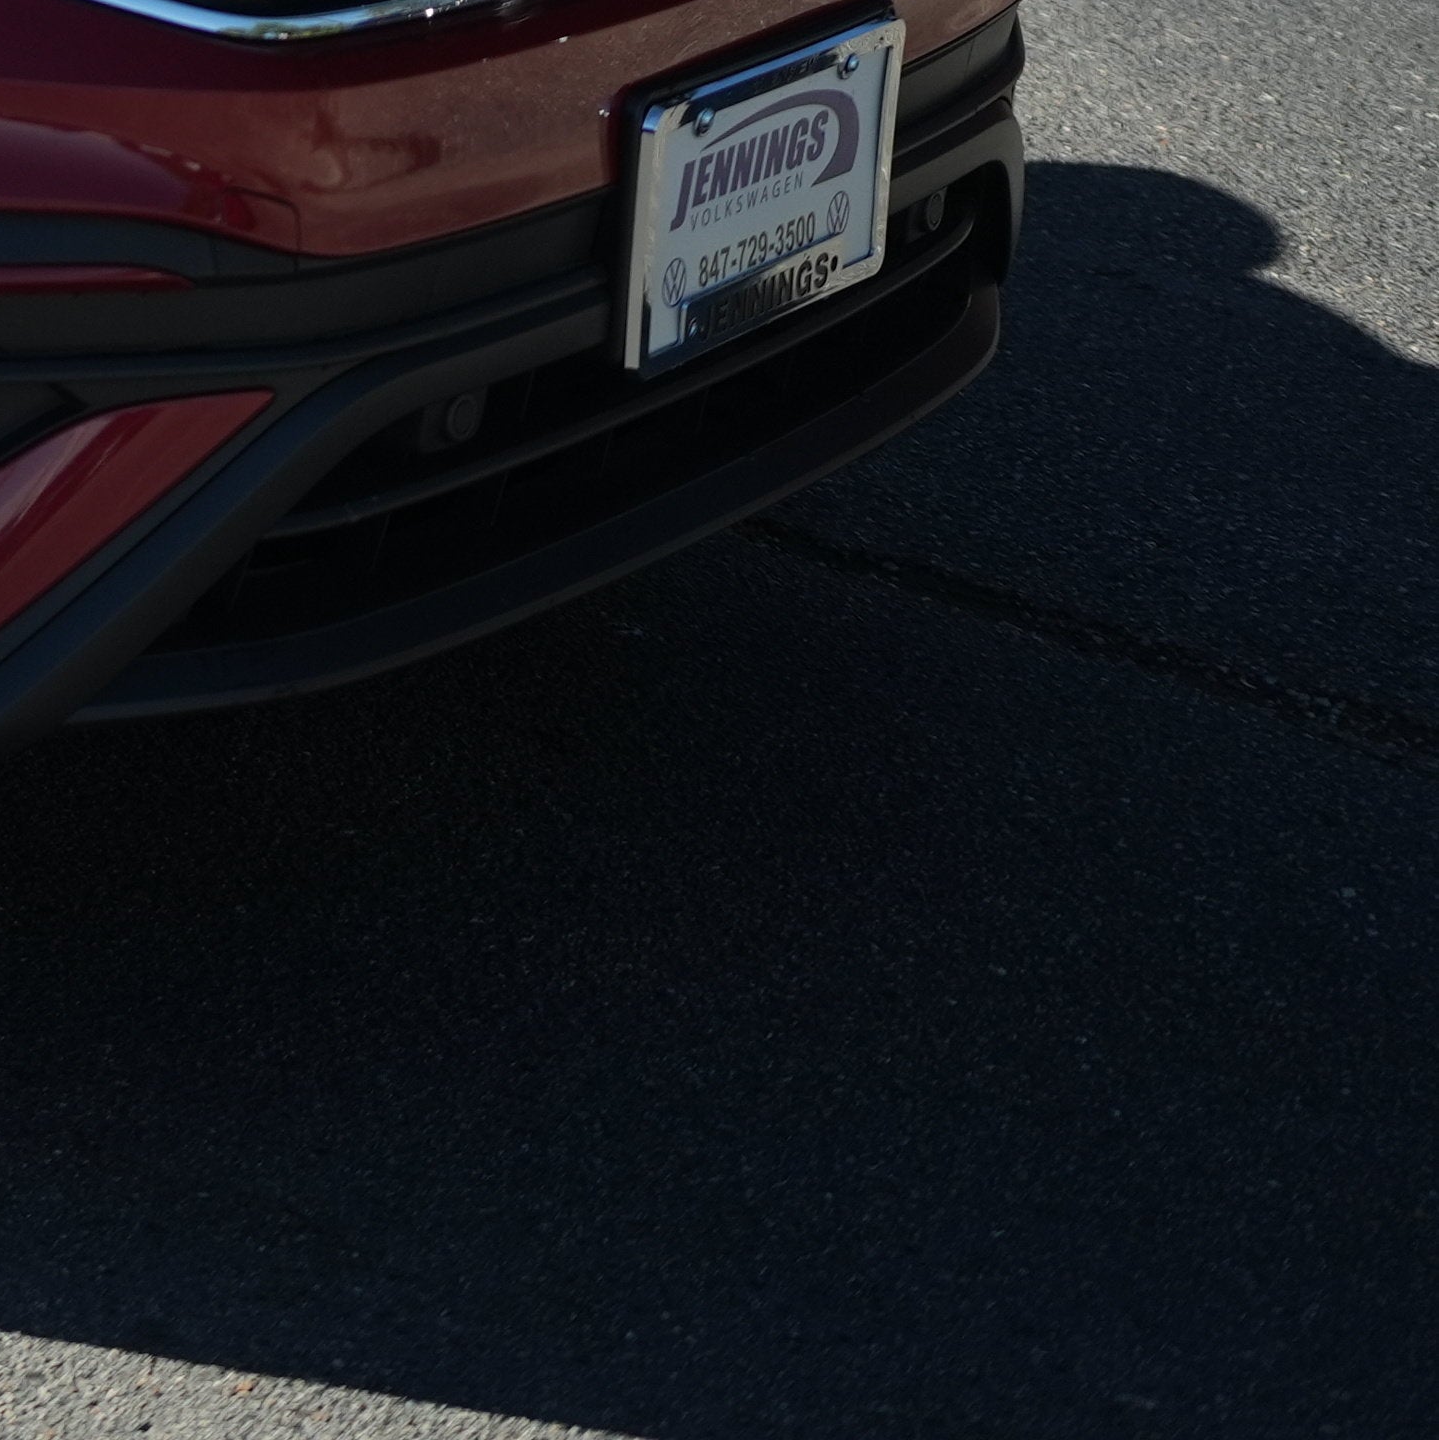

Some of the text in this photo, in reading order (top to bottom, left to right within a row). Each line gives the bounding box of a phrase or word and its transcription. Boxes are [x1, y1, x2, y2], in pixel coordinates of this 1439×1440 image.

[669, 108, 830, 233] JENNINGS
[690, 171, 805, 232] VOLKSWAGEN
[698, 212, 817, 288] 847-729-3500
